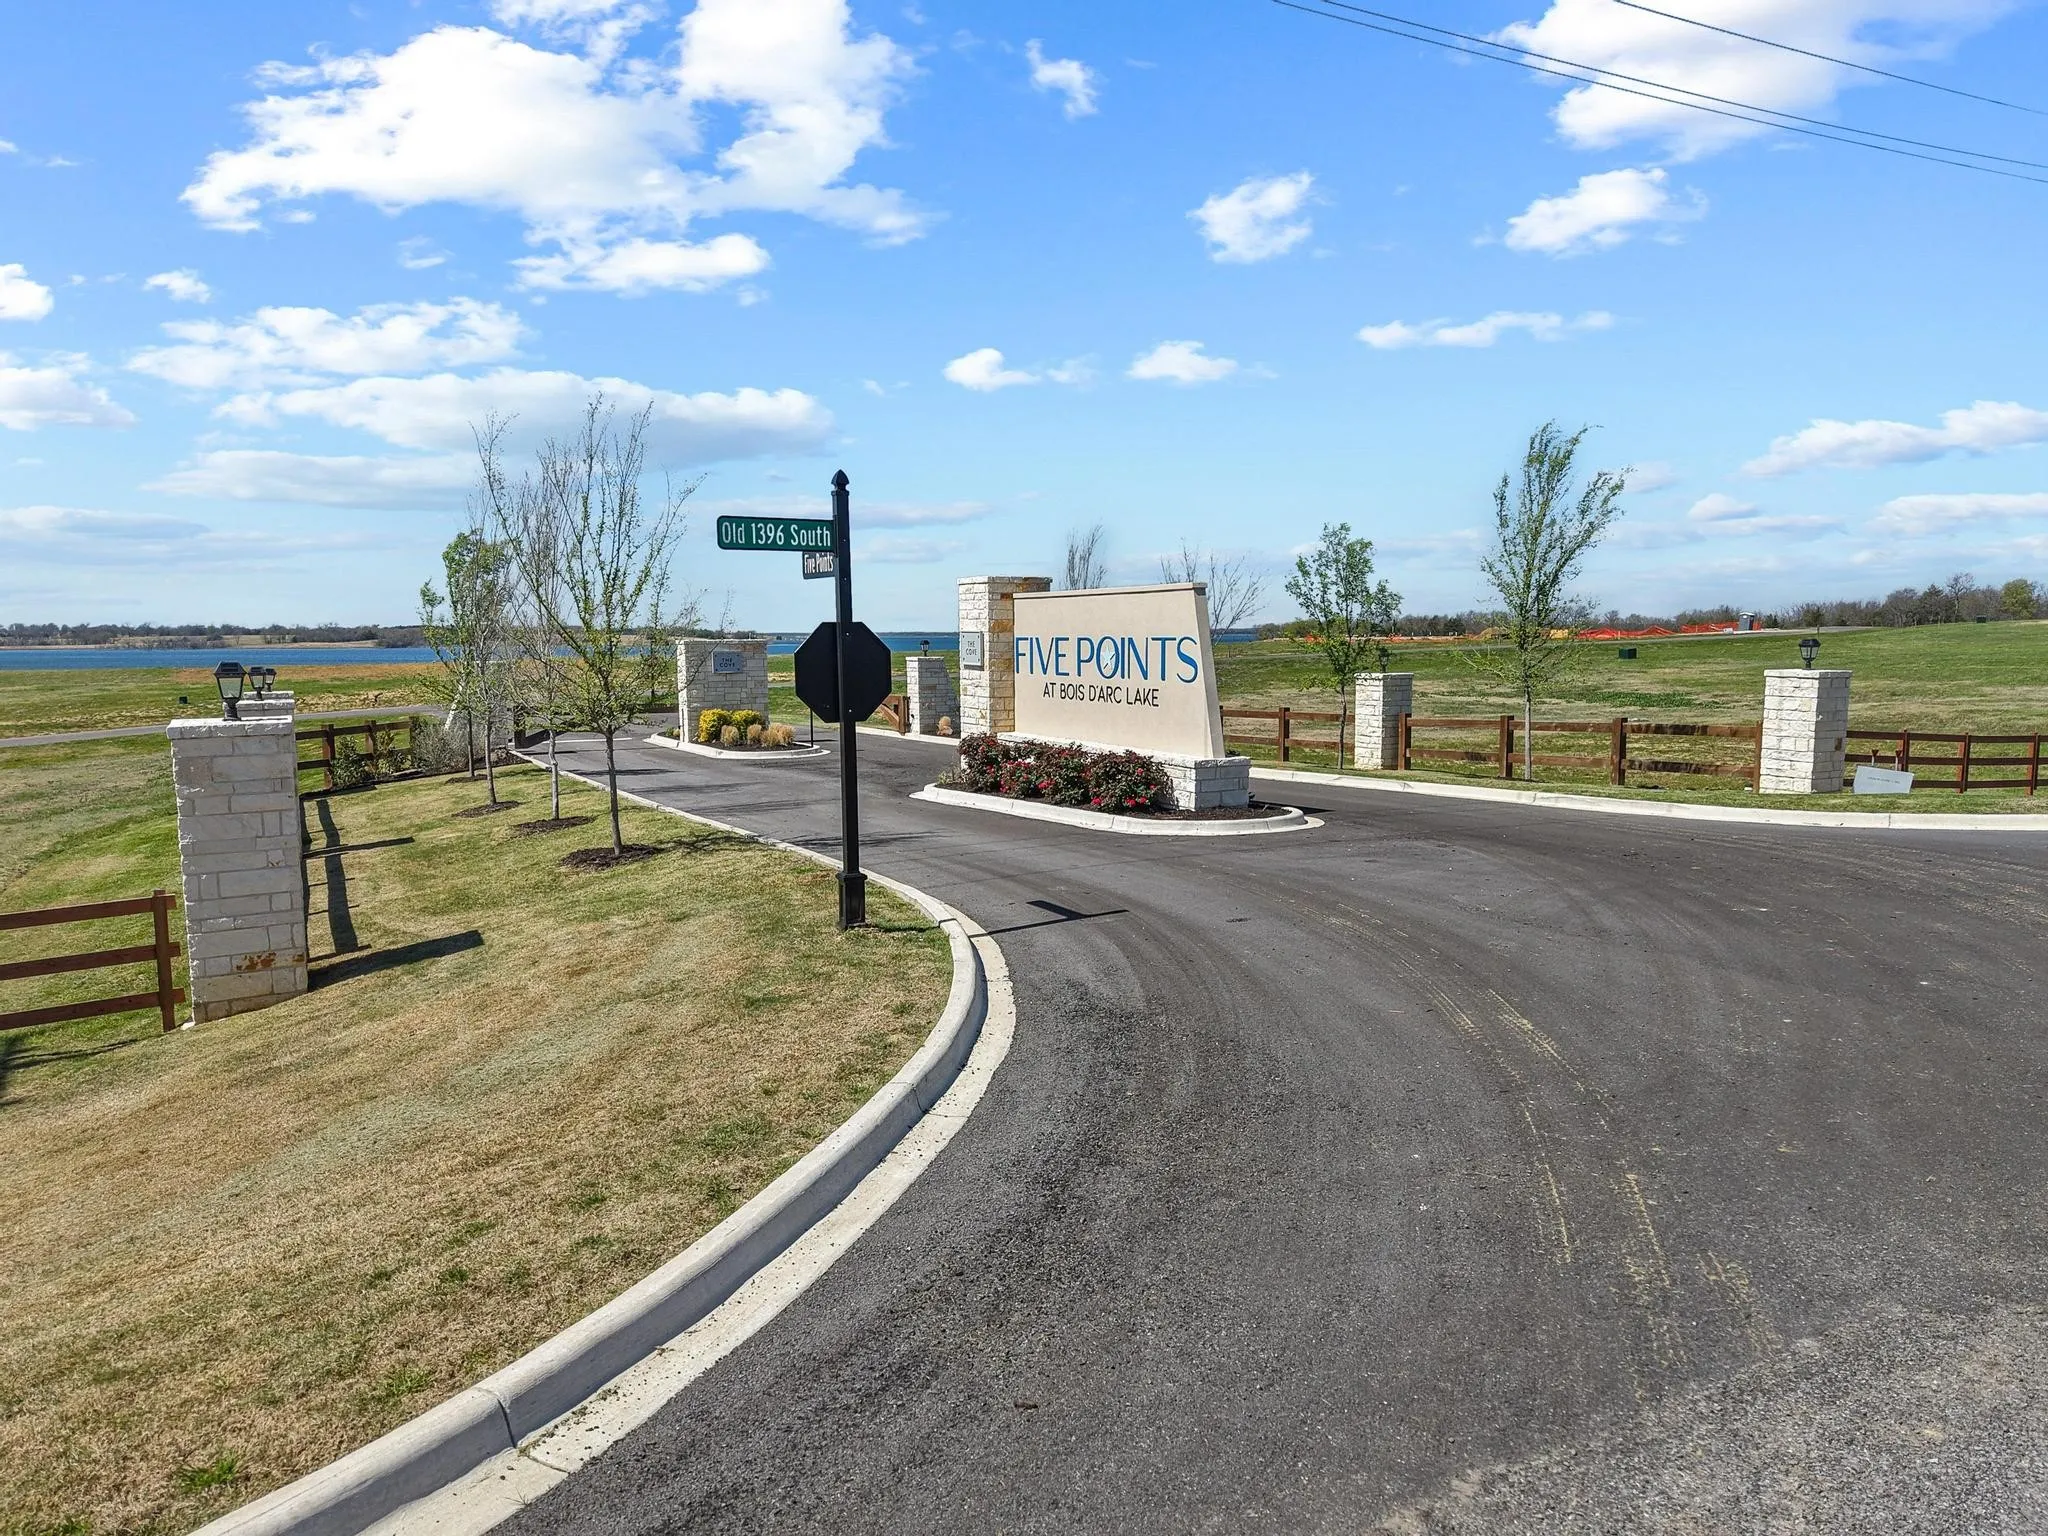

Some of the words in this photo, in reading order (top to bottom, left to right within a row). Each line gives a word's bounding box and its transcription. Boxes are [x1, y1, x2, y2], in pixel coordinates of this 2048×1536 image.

[722, 522, 745, 543] Old
[751, 523, 784, 545] 1396
[791, 524, 831, 547] South
[804, 554, 816, 574] Five
[816, 552, 834, 573] Points
[1015, 636, 1070, 677] FIVE
[1076, 635, 1199, 684] POINTS
[1043, 682, 1057, 699] AT
[1059, 683, 1085, 702] BOIS
[1088, 684, 1122, 704] D'ARC
[1126, 687, 1160, 707] LAKE
